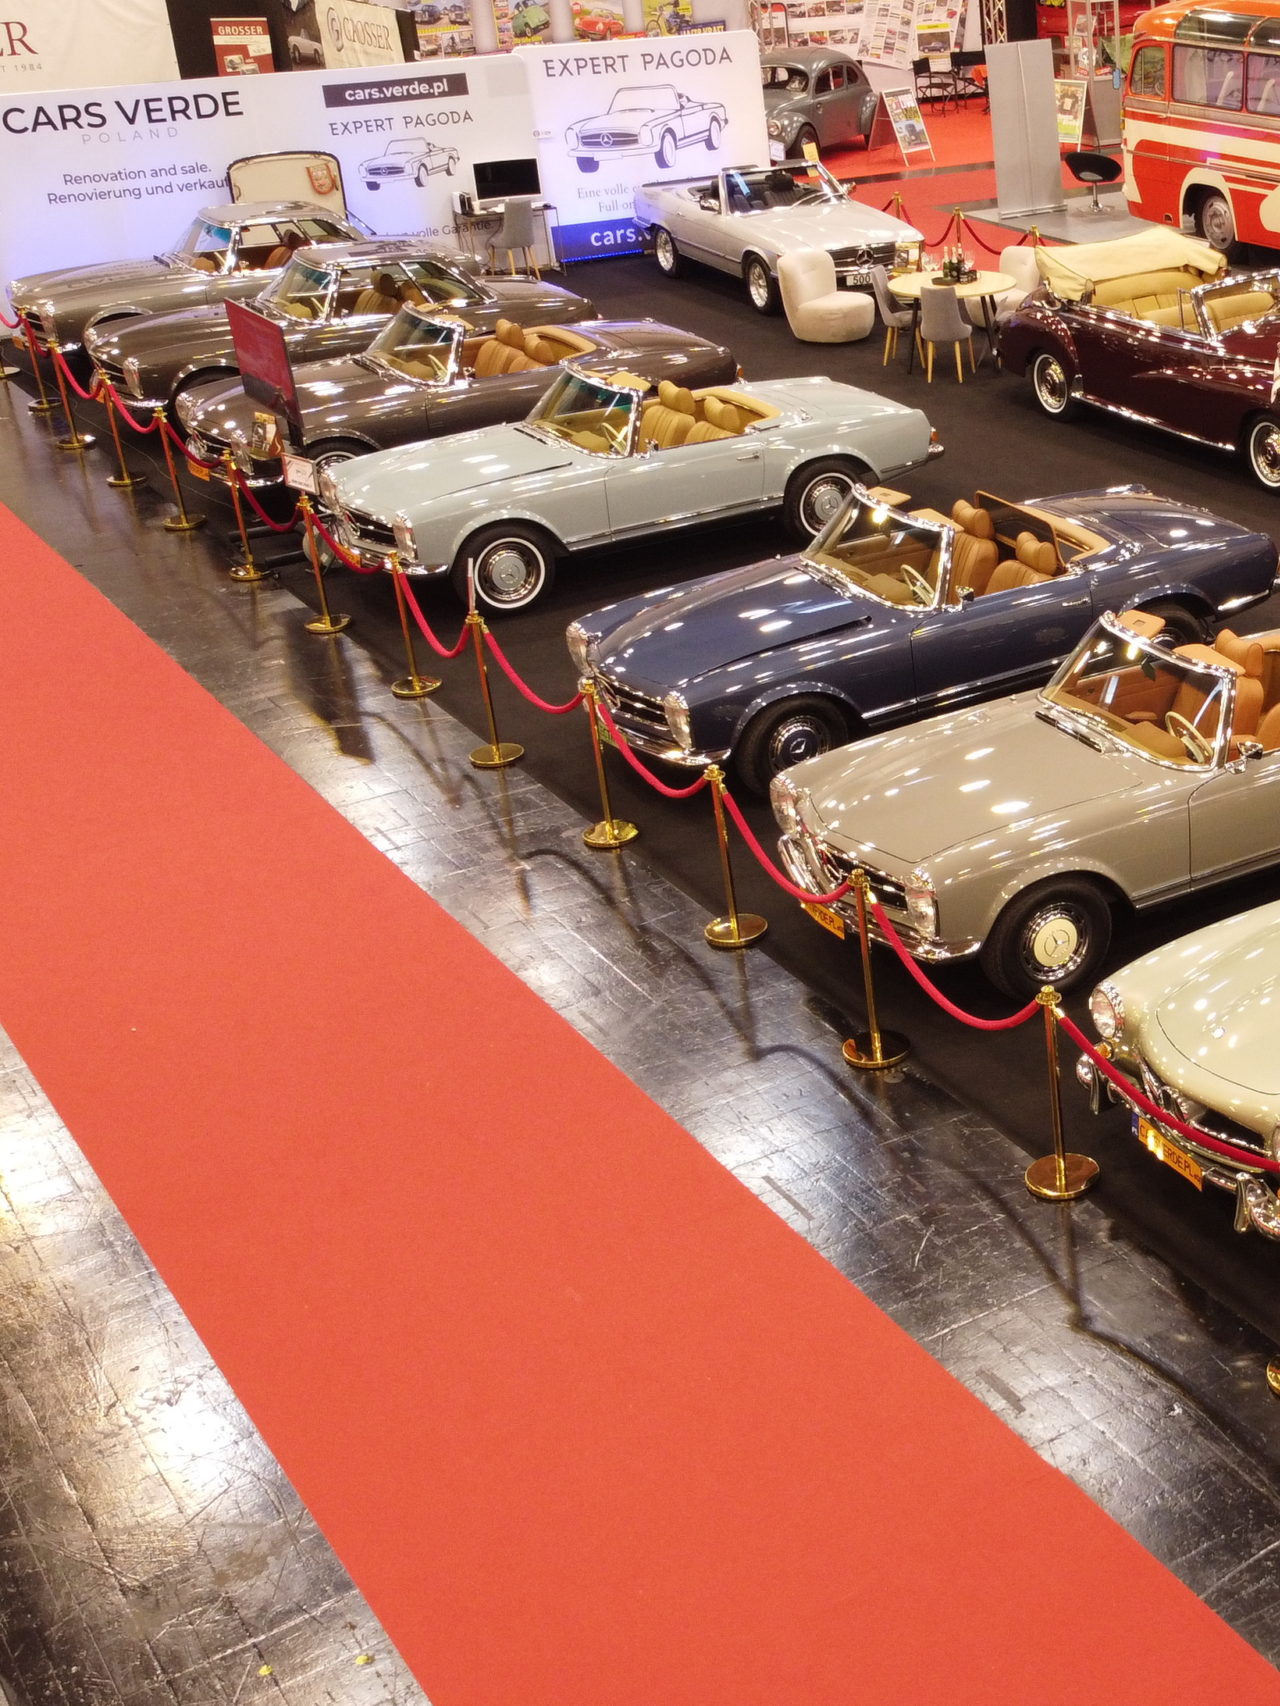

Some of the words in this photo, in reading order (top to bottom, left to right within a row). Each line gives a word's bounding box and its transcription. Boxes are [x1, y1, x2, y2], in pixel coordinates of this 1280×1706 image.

[0, 21, 39, 56] R
[217, 25, 264, 35] GROSSER
[543, 55, 629, 78] EXPERT
[640, 46, 733, 71] PAGODA
[345, 78, 449, 101] cars.verde.pl
[2, 102, 107, 134] CARS
[114, 91, 244, 125] VERDE
[329, 117, 394, 136] EXPERT
[402, 110, 473, 129] PAGODA
[82, 126, 178, 145] POLAND
[63, 168, 147, 186] Renovation
[150, 163, 177, 178] and
[180, 162, 212, 175] sale.
[47, 185, 142, 205] Renovierung
[145, 182, 174, 196] und
[577, 187, 601, 199] Eine
[604, 183, 629, 197] volle
[599, 200, 619, 213] Full
[590, 227, 651, 247] cars.v
[853, 274, 871, 285] 500
